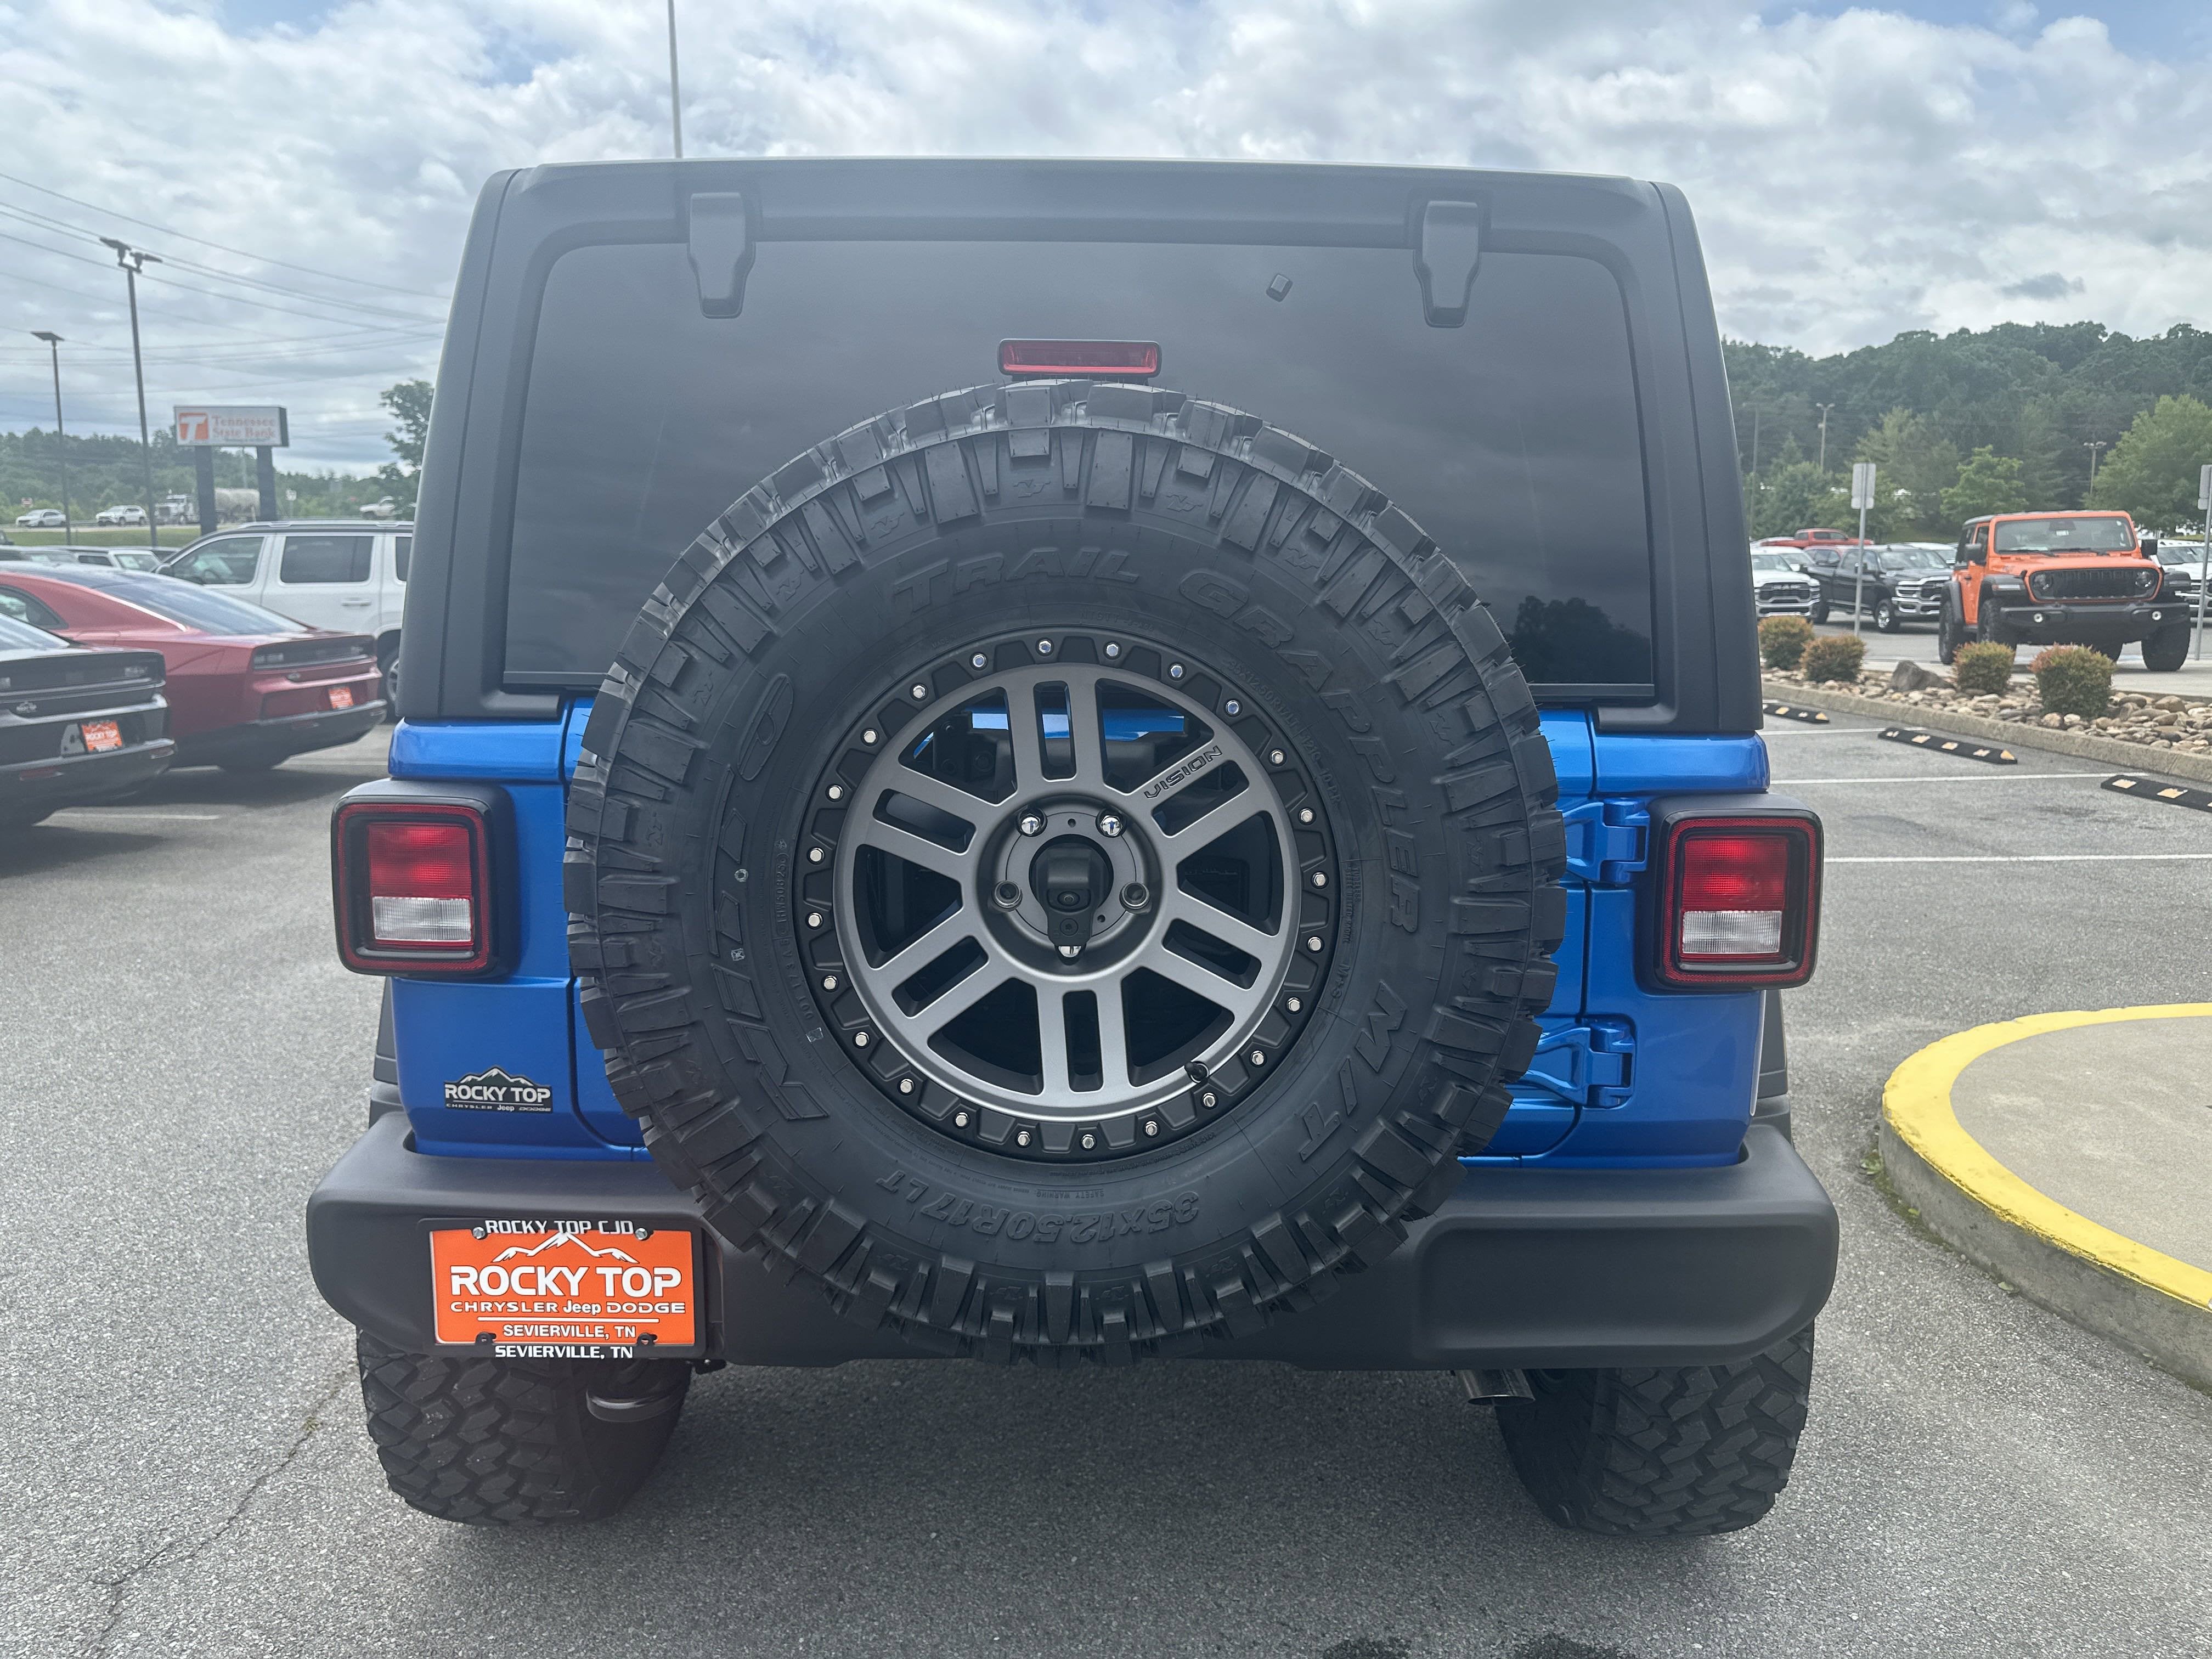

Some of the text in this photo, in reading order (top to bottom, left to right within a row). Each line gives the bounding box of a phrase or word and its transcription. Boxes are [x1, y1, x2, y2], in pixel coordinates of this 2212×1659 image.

[212, 415, 275, 427] Tennessee
[212, 427, 274, 438] State Bank
[1143, 746, 1222, 799] VISION
[893, 548, 1419, 1161] TRAIL GRAPPLER M/T
[706, 674, 830, 1121] NITTO
[444, 1084, 550, 1103] ROCKY TOP
[497, 1104, 515, 1112] Jeep
[1074, 1188, 1104, 1199] SAFETY
[484, 1220, 634, 1235] ROCKY TOP CJD
[450, 1265, 682, 1298] ROCKY TOP
[450, 1299, 686, 1316] CHRYSLER Jeep DODGE
[503, 1324, 636, 1340] SEVIERVILLE, TN
[495, 1345, 633, 1360] SEVIERVILLE, TN
